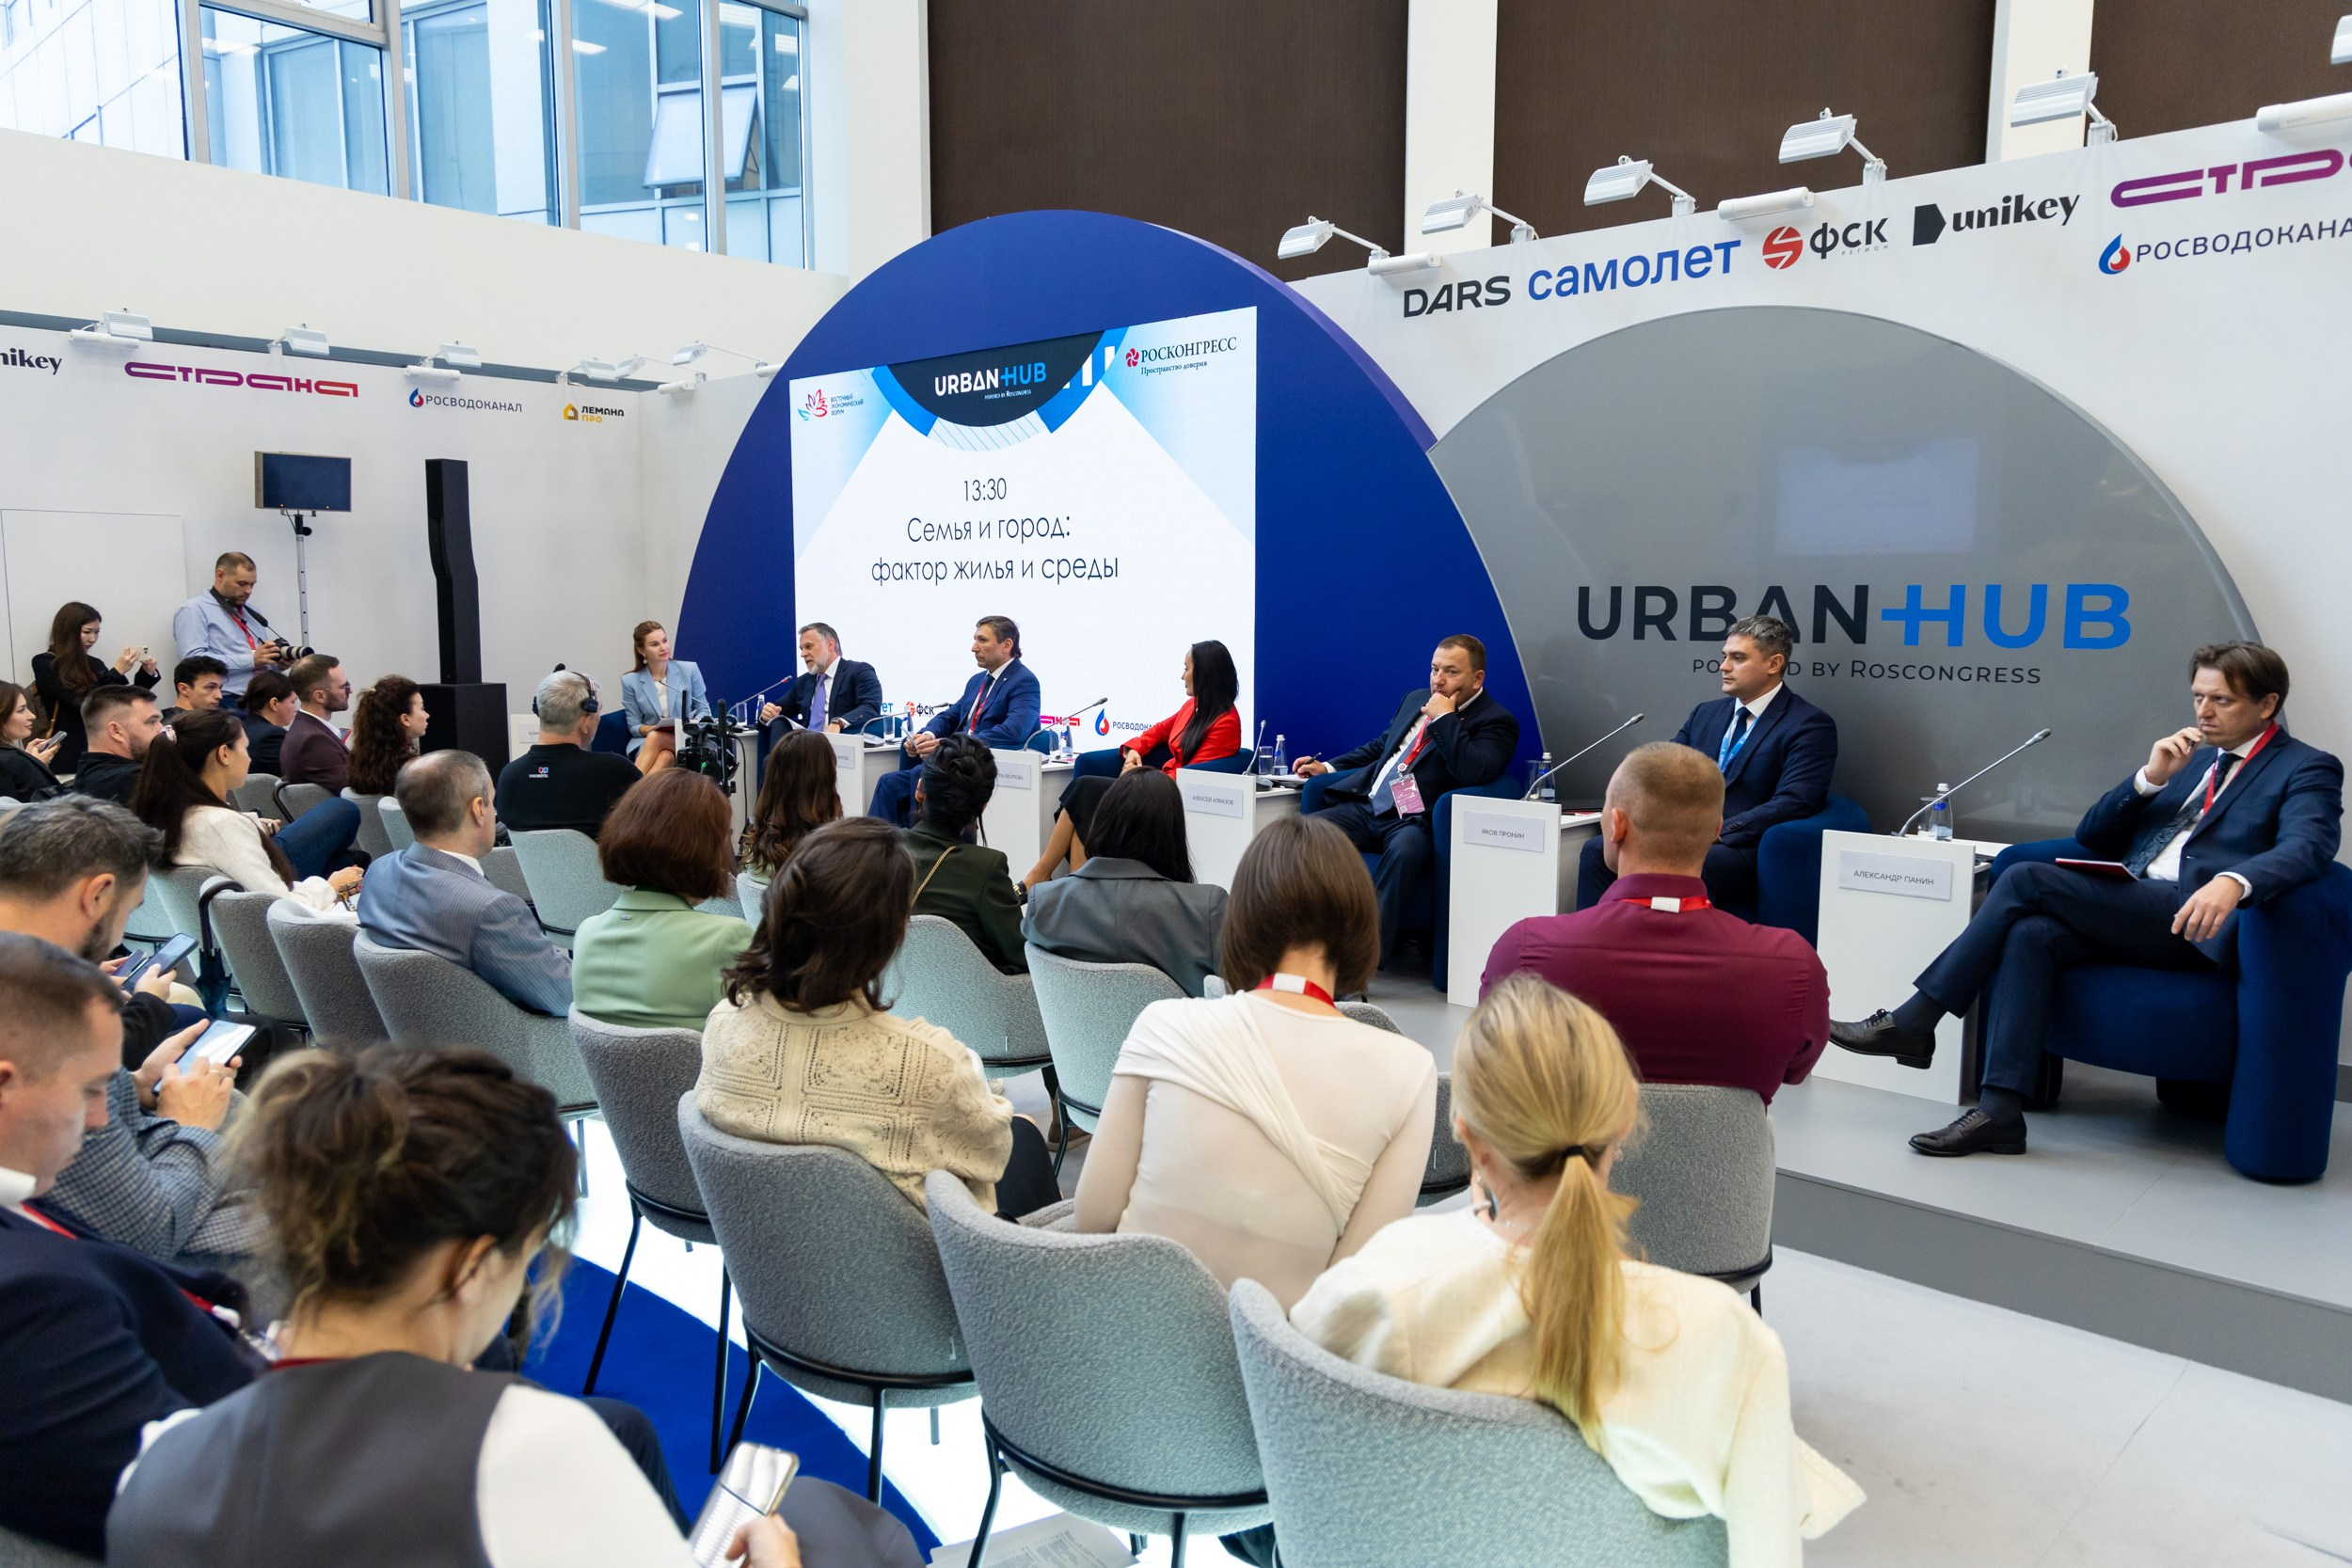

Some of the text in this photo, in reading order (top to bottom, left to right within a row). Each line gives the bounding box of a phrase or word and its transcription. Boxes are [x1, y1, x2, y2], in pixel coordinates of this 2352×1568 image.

[2110, 149, 2352, 208] СТР
[1953, 194, 2080, 232] unikey
[1810, 217, 1888, 260] ФСК
[1841, 244, 1889, 256] РЕГИОН
[2136, 217, 2352, 262] РОСВОДОКАНА
[1528, 239, 1741, 301] самолет
[1404, 276, 1511, 318] DARS
[1141, 337, 1237, 363] РОСКОНГРЕСС
[1141, 363, 1183, 376] Пространство
[426, 395, 522, 413] РОСВОДОКАНАЛ
[581, 405, 625, 417] ЛЕМАНА
[581, 414, 603, 423] ПРО
[963, 477, 1007, 501] 13:30
[907, 515, 1071, 545] Семья и город:
[871, 557, 1119, 587] фактор жилья и среды
[1812, 661, 1840, 677] BY
[1481, 828, 1525, 839] ЯКОВ ПРОНИН
[1852, 869, 1934, 886] АЛЕКСАНДР ПАНИН
